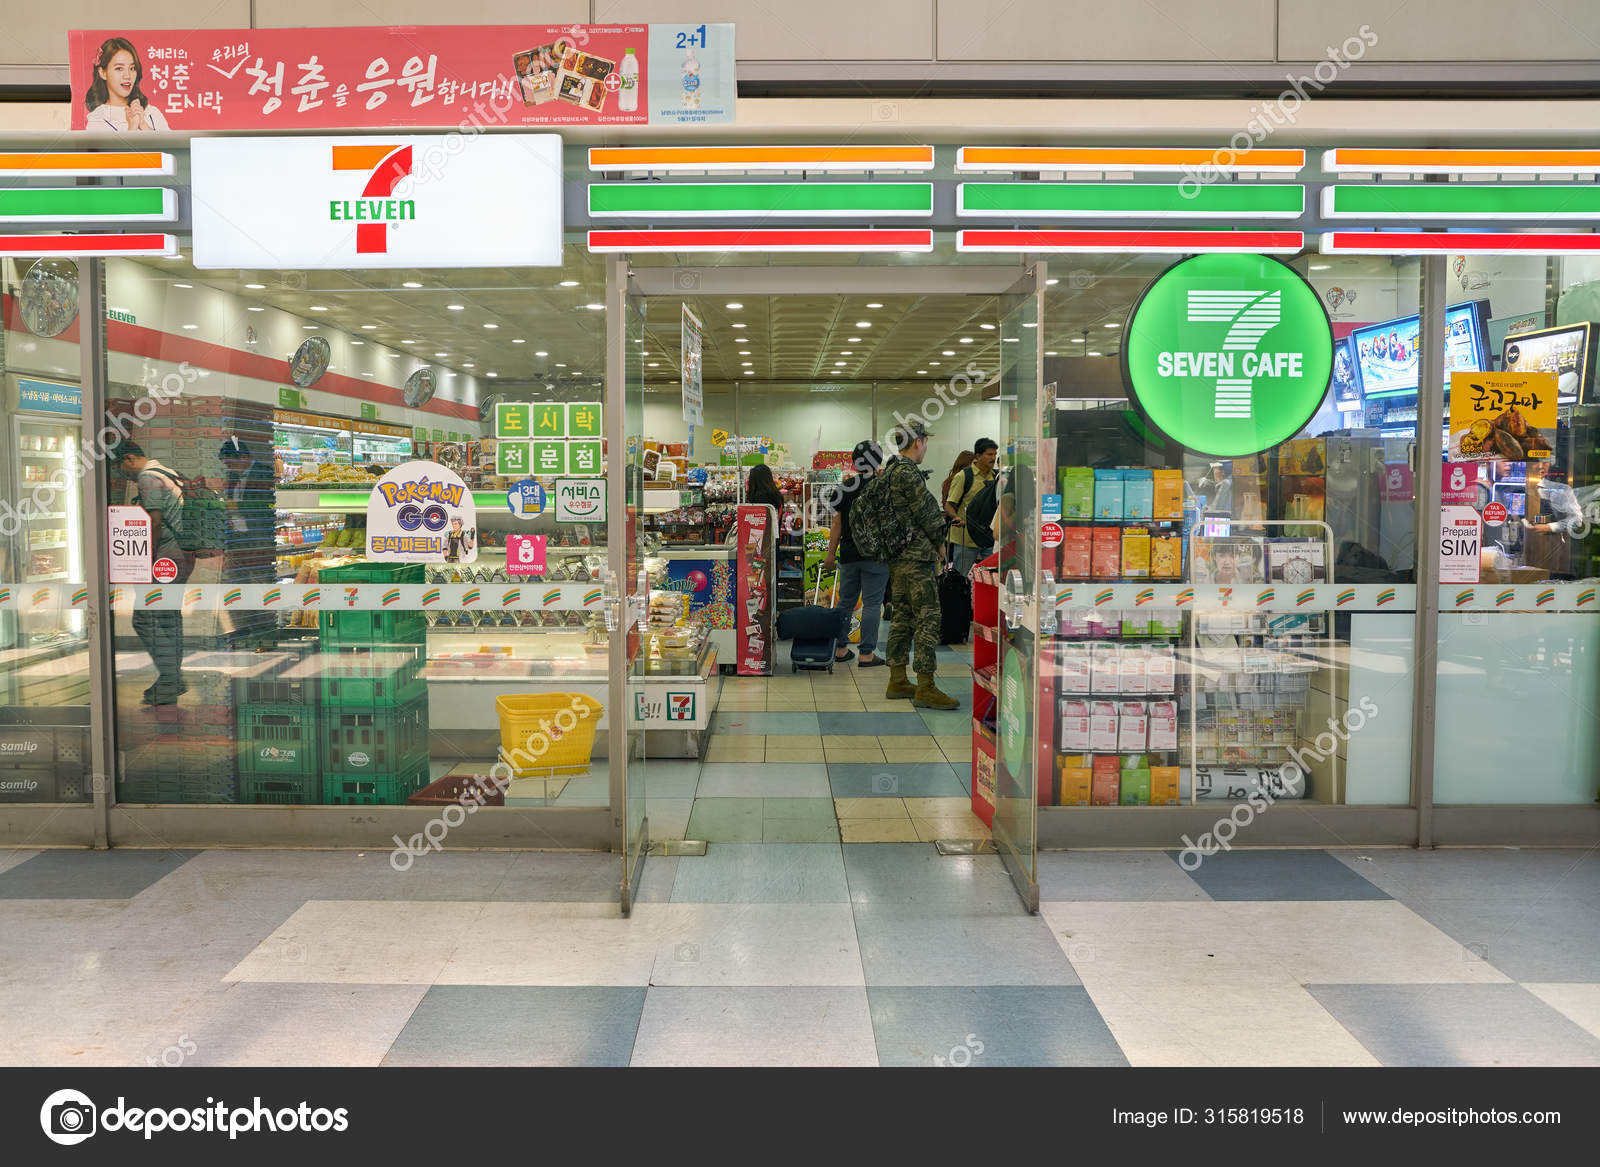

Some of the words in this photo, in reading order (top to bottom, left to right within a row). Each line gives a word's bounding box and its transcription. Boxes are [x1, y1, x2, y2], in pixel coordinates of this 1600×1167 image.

[676, 25, 706, 48] 2+1
[148, 46, 188, 60] 혜리의
[211, 43, 250, 62] 우리의
[150, 64, 191, 90] 청춘
[246, 56, 350, 115] 청춘을
[165, 92, 223, 115] 도시락
[332, 144, 413, 254] 7
[1157, 352, 1234, 376] SEVEN
[1242, 352, 1303, 377] CAFE
[1470, 384, 1543, 413] 군고구마
[504, 410, 594, 431] 도시락
[505, 449, 593, 469] 전문점
[523, 485, 540, 497] 3대
[561, 486, 600, 500] 서비스
[397, 504, 448, 531] GO
[113, 528, 147, 538] Prepaid
[1442, 527, 1477, 538] Prepaid
[113, 540, 147, 556] SIM
[1441, 540, 1477, 556] SIM
